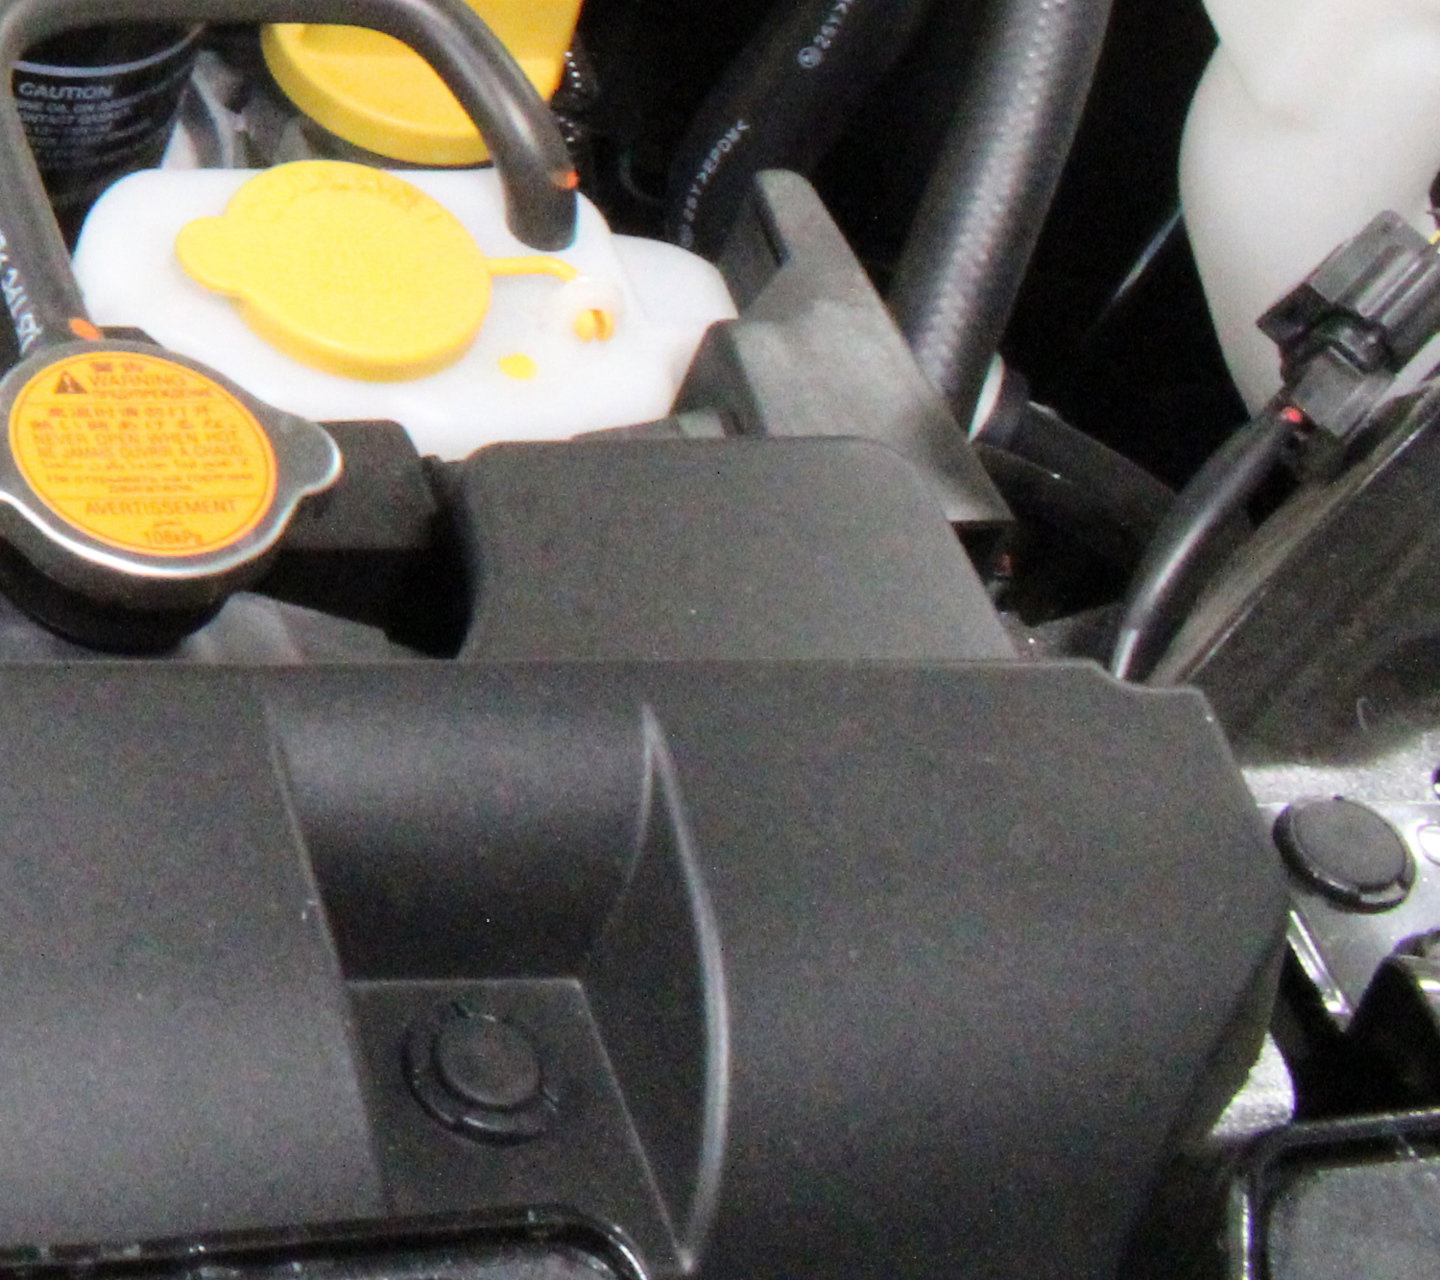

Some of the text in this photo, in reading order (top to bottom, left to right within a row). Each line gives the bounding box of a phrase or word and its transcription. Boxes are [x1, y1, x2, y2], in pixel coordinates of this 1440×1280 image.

[18, 81, 113, 100] CAUTION
[90, 373, 186, 388] WARNING
[95, 430, 140, 444] OPEN
[148, 430, 198, 444] WHEN
[206, 430, 238, 444] HOT
[85, 500, 238, 515] AVERTISSEMENT
